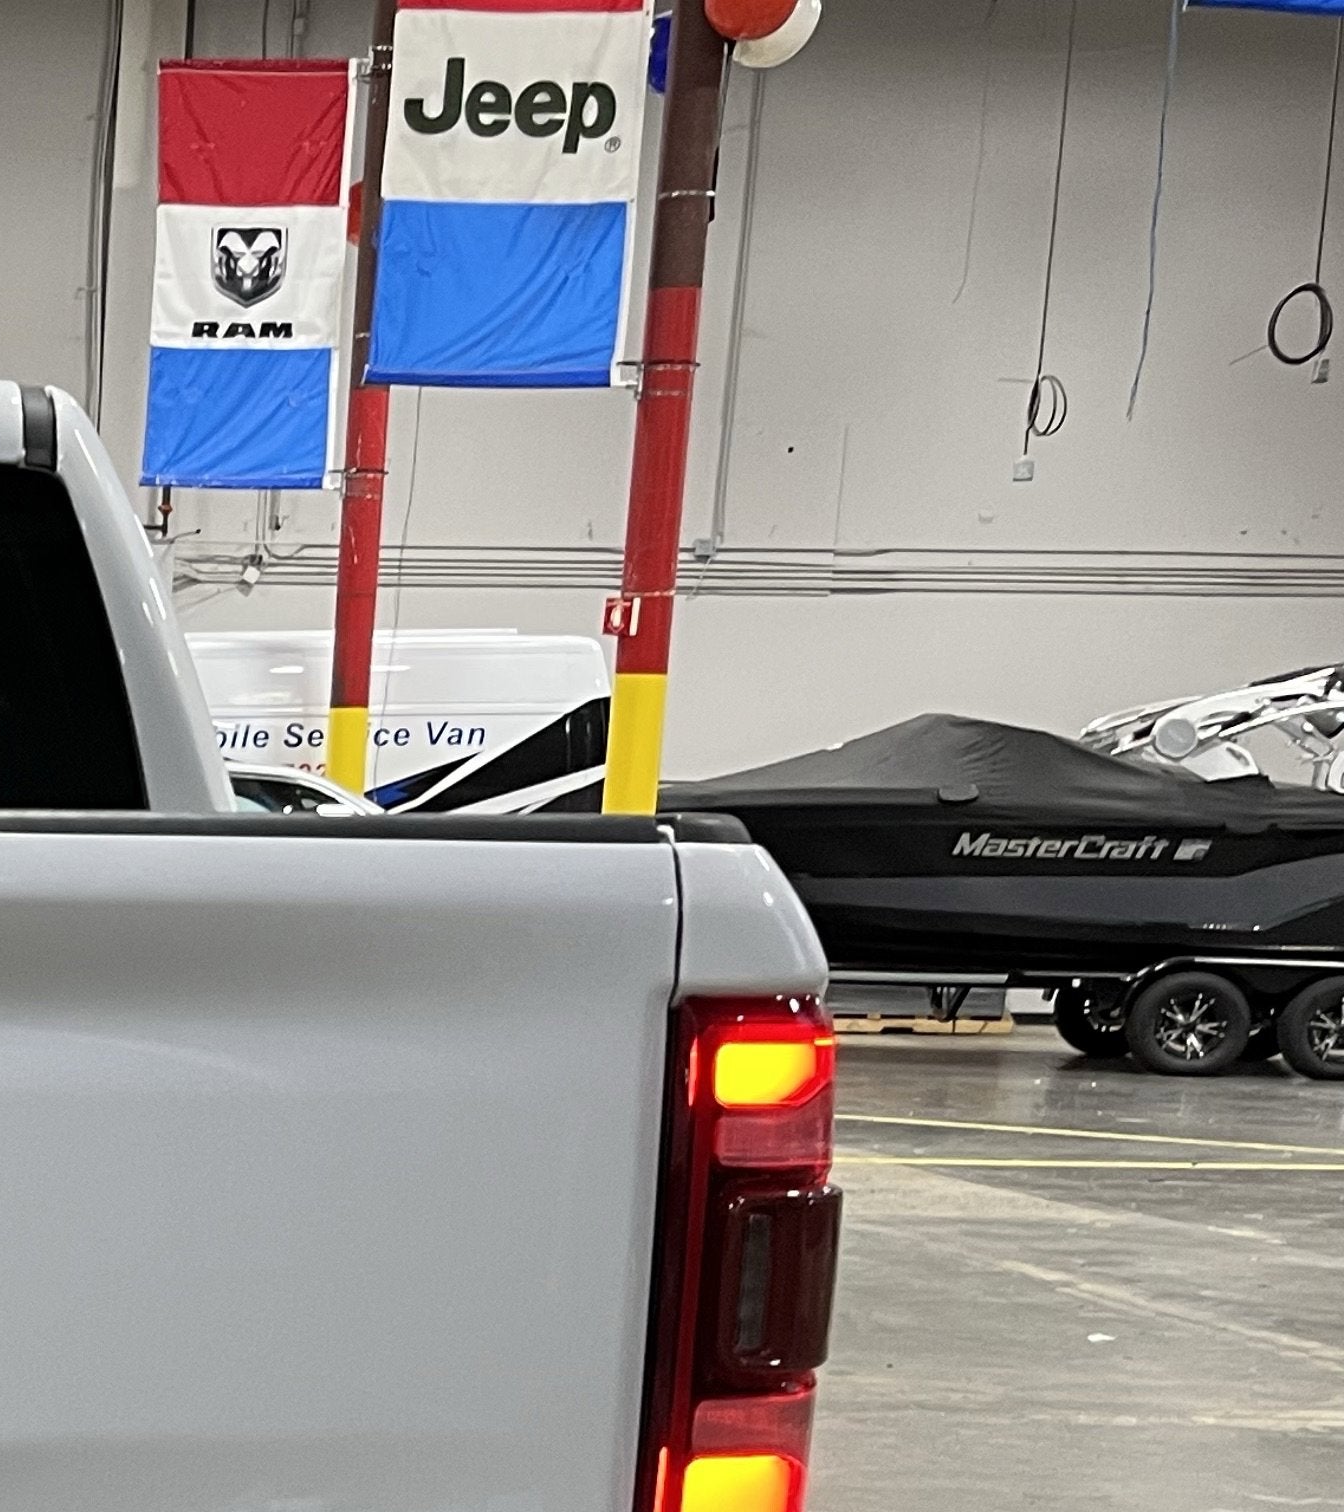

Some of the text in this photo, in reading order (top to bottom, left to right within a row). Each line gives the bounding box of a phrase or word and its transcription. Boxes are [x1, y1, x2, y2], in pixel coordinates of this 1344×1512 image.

[404, 57, 616, 154] Jeep
[191, 322, 293, 339] RAM
[216, 724, 269, 749] ile
[426, 721, 486, 747] Van
[952, 832, 1170, 860] MasterCraft
